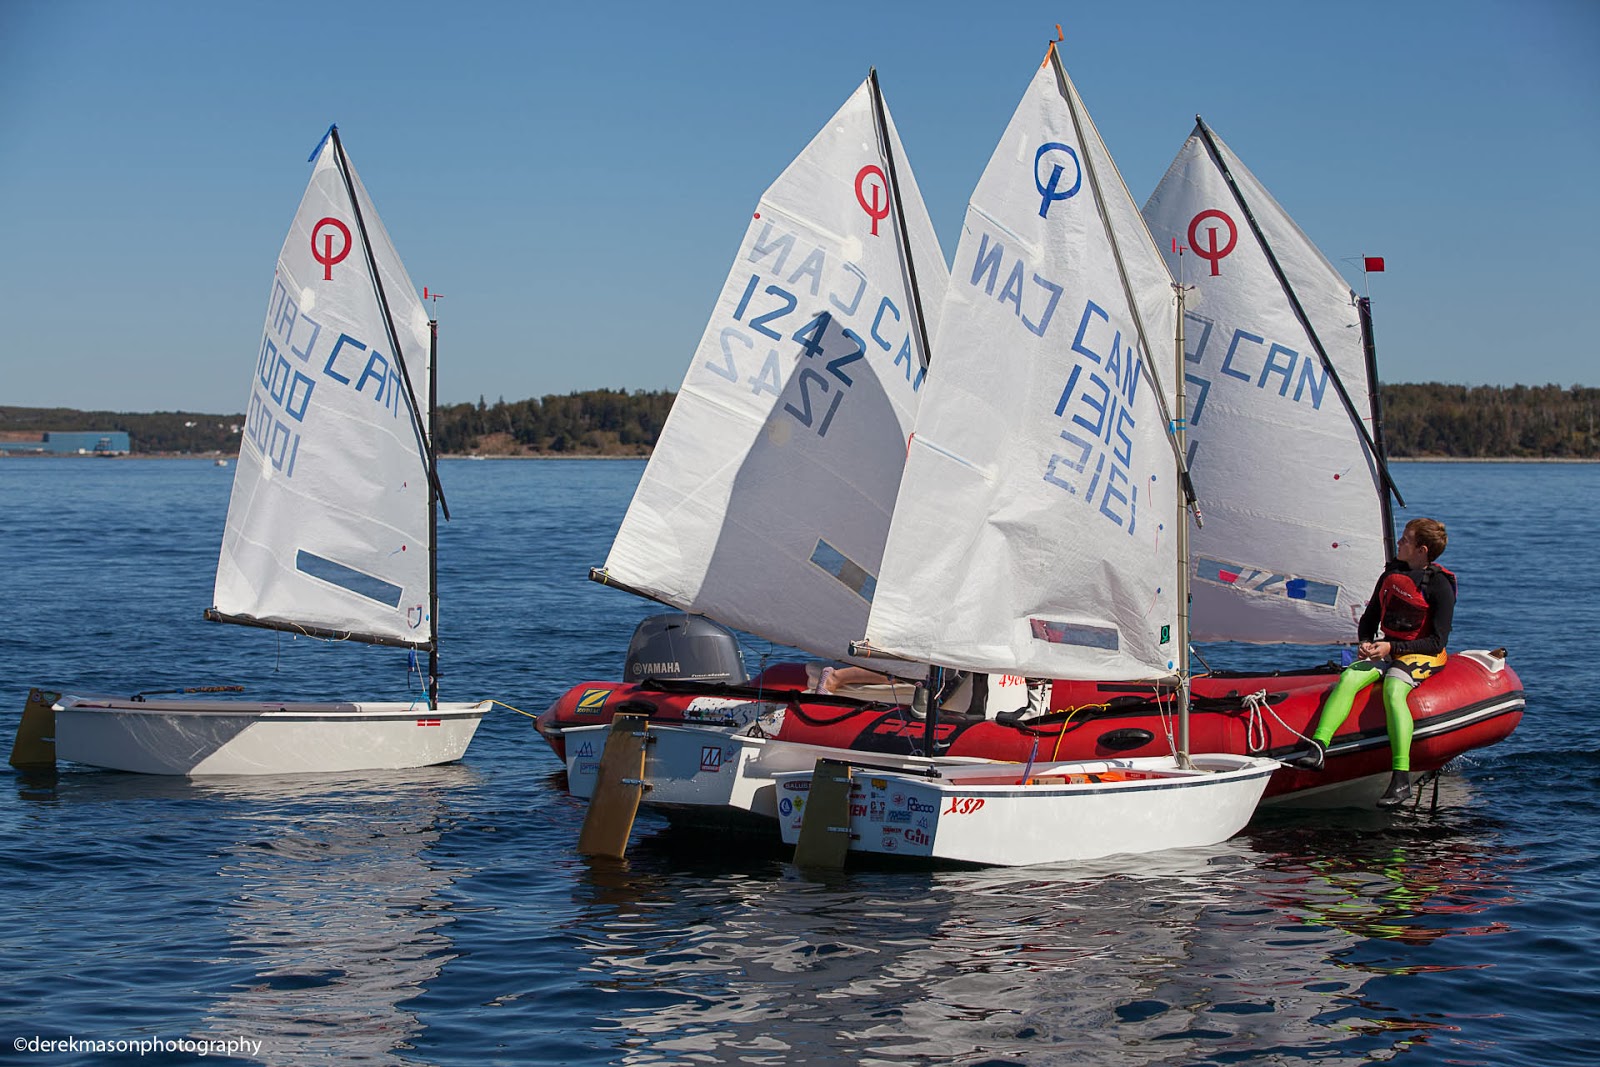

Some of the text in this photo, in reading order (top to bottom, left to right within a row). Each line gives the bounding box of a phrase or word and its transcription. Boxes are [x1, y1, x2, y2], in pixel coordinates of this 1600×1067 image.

[733, 274, 867, 388] 1242
[1071, 299, 1142, 408] CAN
[1220, 328, 1331, 411] CAN
[257, 332, 317, 423] 1000
[323, 332, 401, 419] CAN
[642, 662, 681, 674] YAMAHA
[904, 828, 930, 846] Gill
[943, 797, 985, 816] XSP
